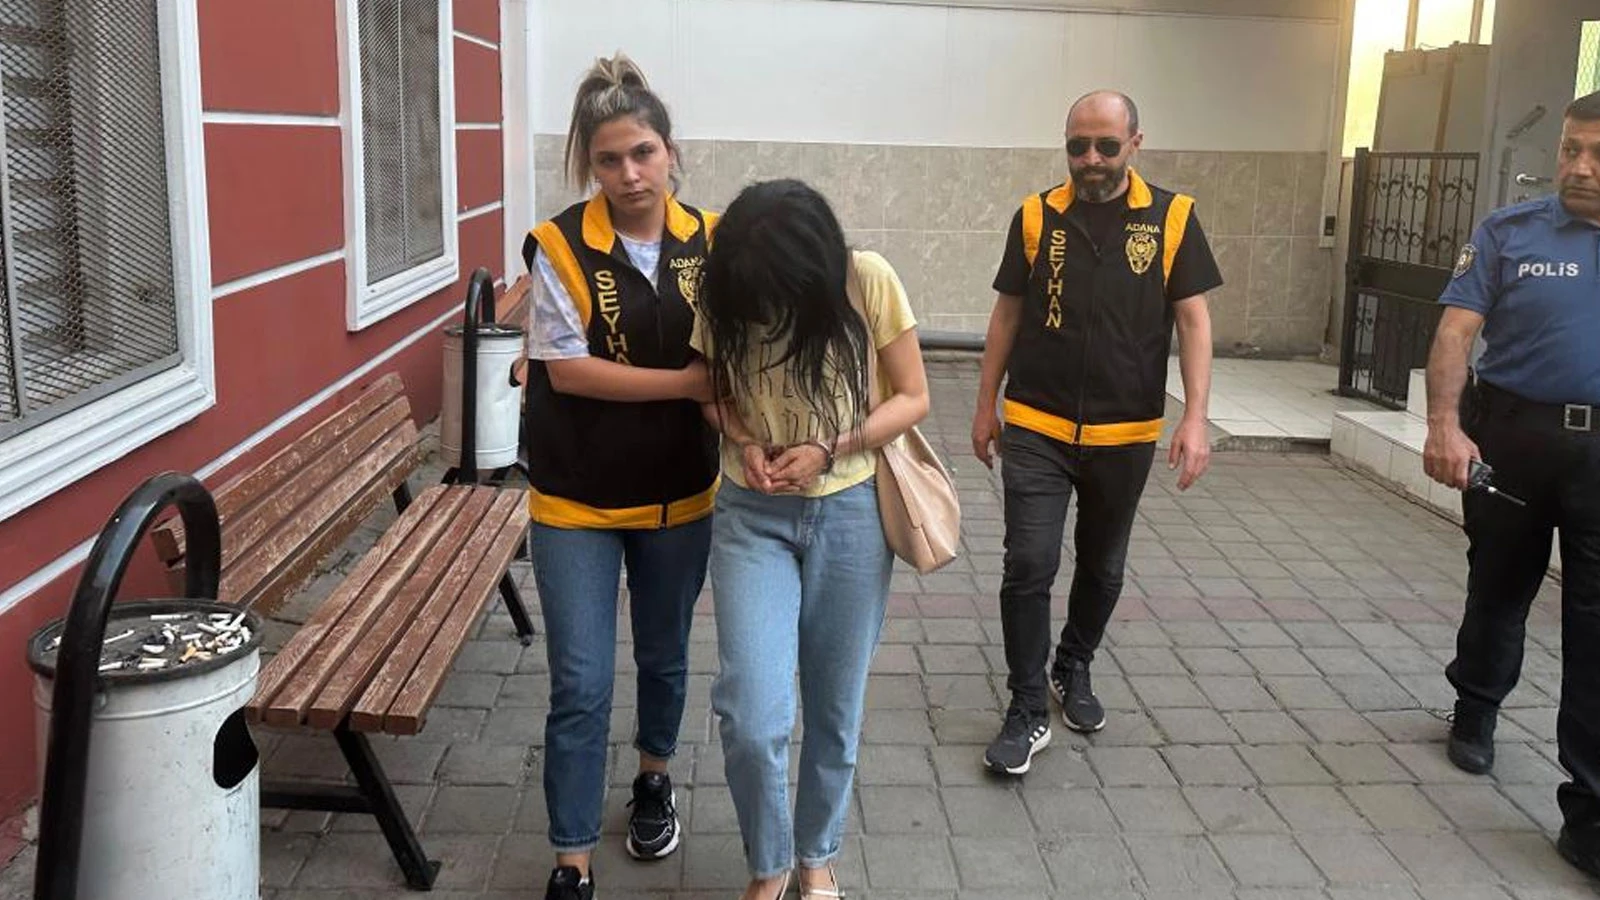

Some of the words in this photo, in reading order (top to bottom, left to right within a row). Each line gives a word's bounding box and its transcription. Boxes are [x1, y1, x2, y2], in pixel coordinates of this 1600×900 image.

[1125, 223, 1160, 233] ADANA
[594, 269, 632, 365] SEYHA
[1045, 230, 1067, 328] SEYHAN
